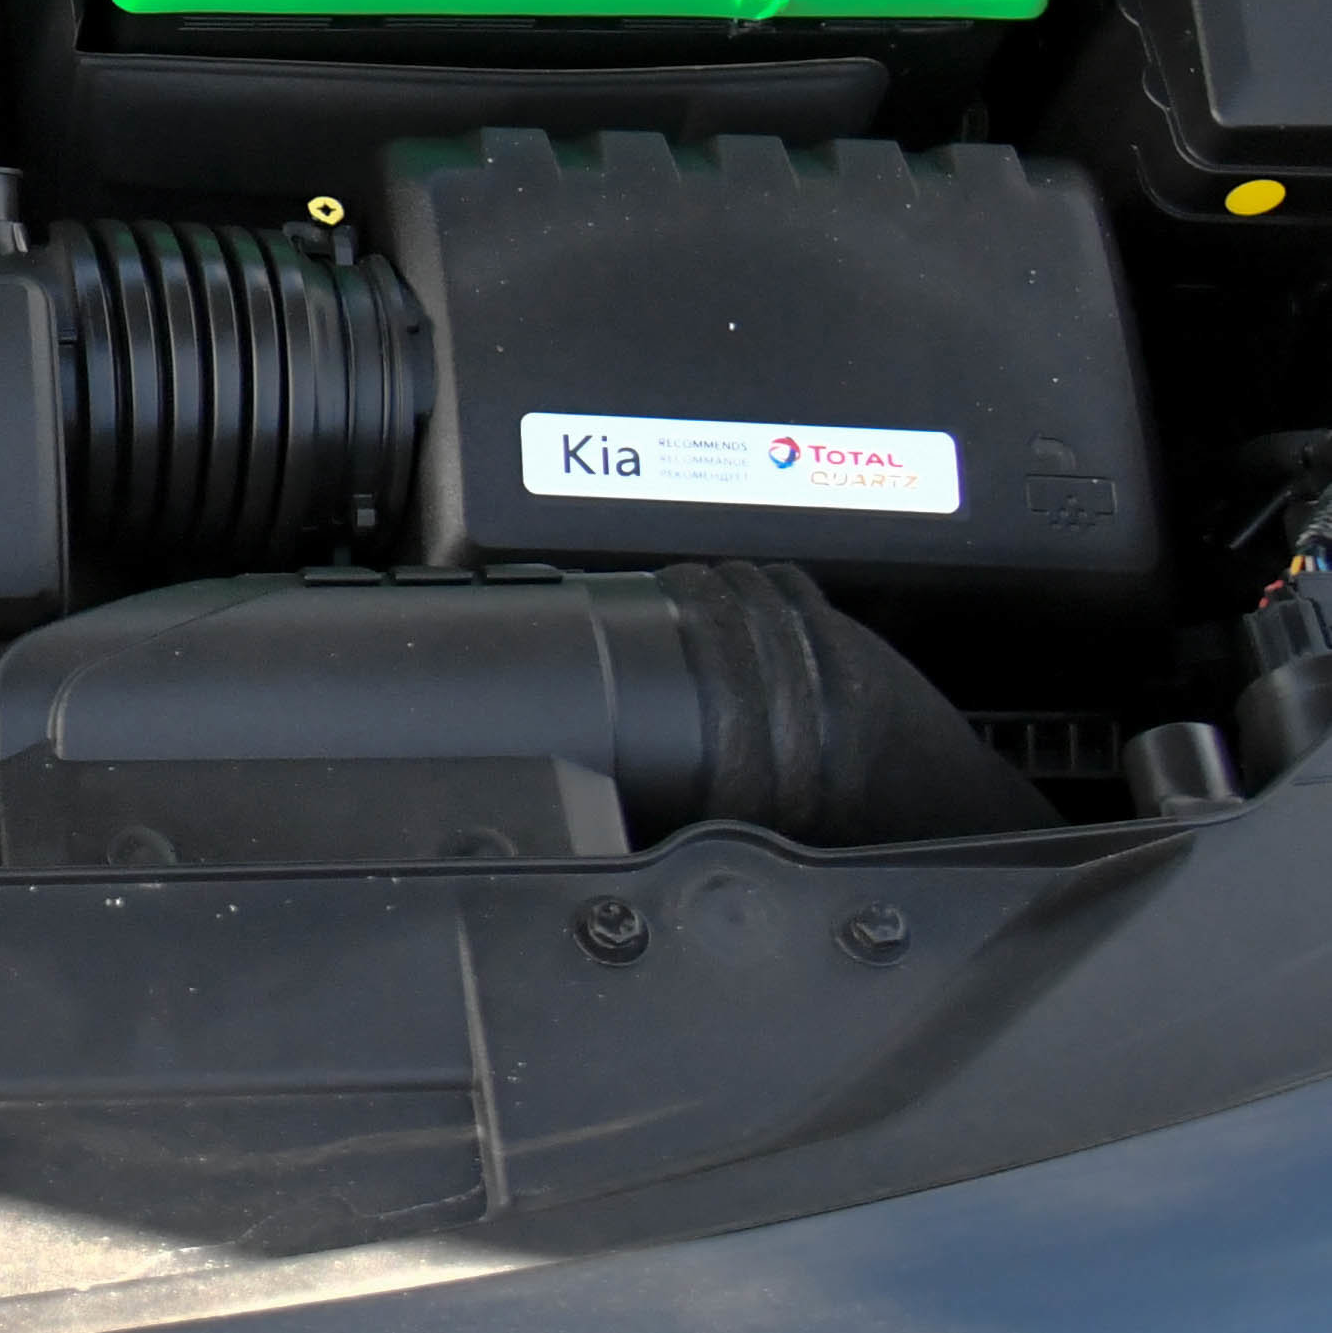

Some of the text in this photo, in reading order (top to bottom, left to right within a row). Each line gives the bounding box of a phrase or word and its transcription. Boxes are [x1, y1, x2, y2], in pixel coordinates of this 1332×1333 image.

[658, 437, 748, 452] RECOMMENDS
[561, 433, 642, 478] Kia
[807, 445, 904, 468] TOTAL
[810, 471, 920, 490] QUARTZ
